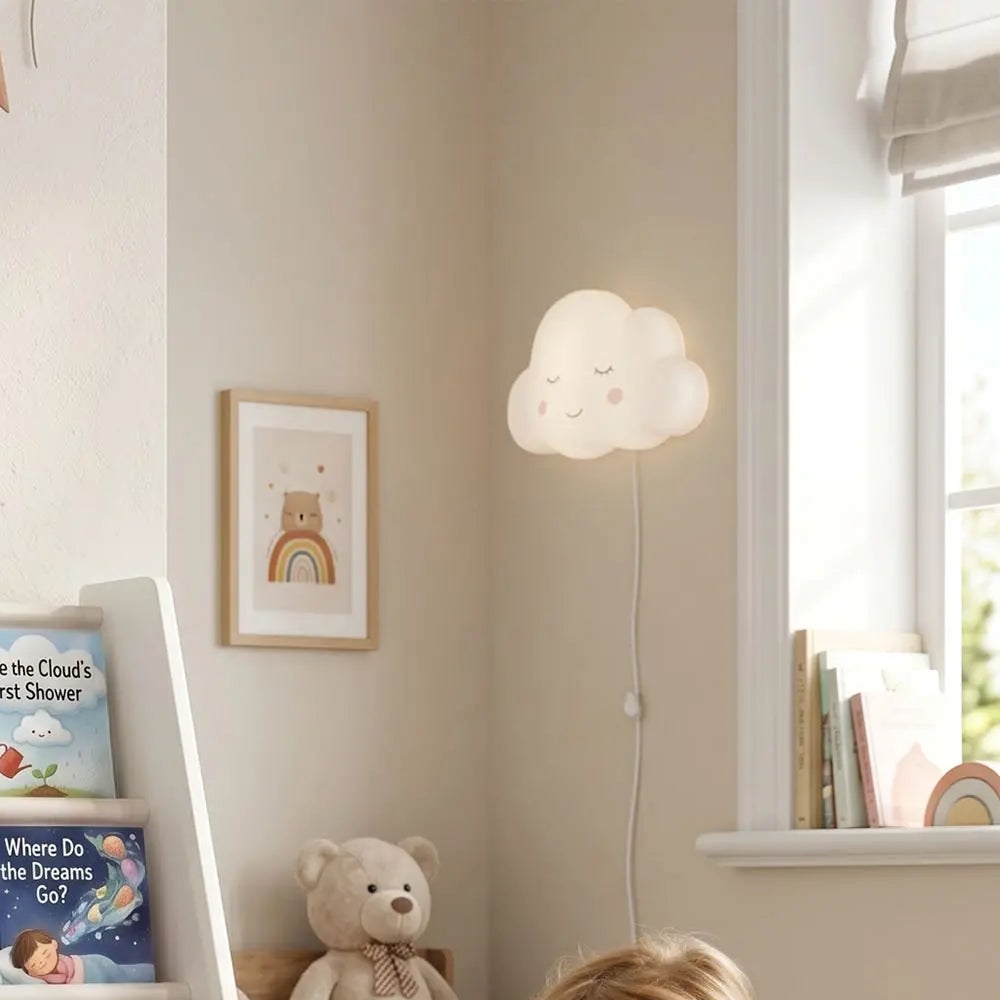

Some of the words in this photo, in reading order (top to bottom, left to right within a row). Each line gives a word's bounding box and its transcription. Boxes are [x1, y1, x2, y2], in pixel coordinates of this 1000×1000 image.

[12, 659, 34, 677] the
[38, 659, 92, 679] Cloud's
[25, 682, 82, 702] Shower
[5, 838, 57, 857] Where
[62, 839, 84, 857] Do
[0, 862, 26, 880] the
[32, 862, 93, 880] Dreams
[36, 885, 67, 904] Go?
